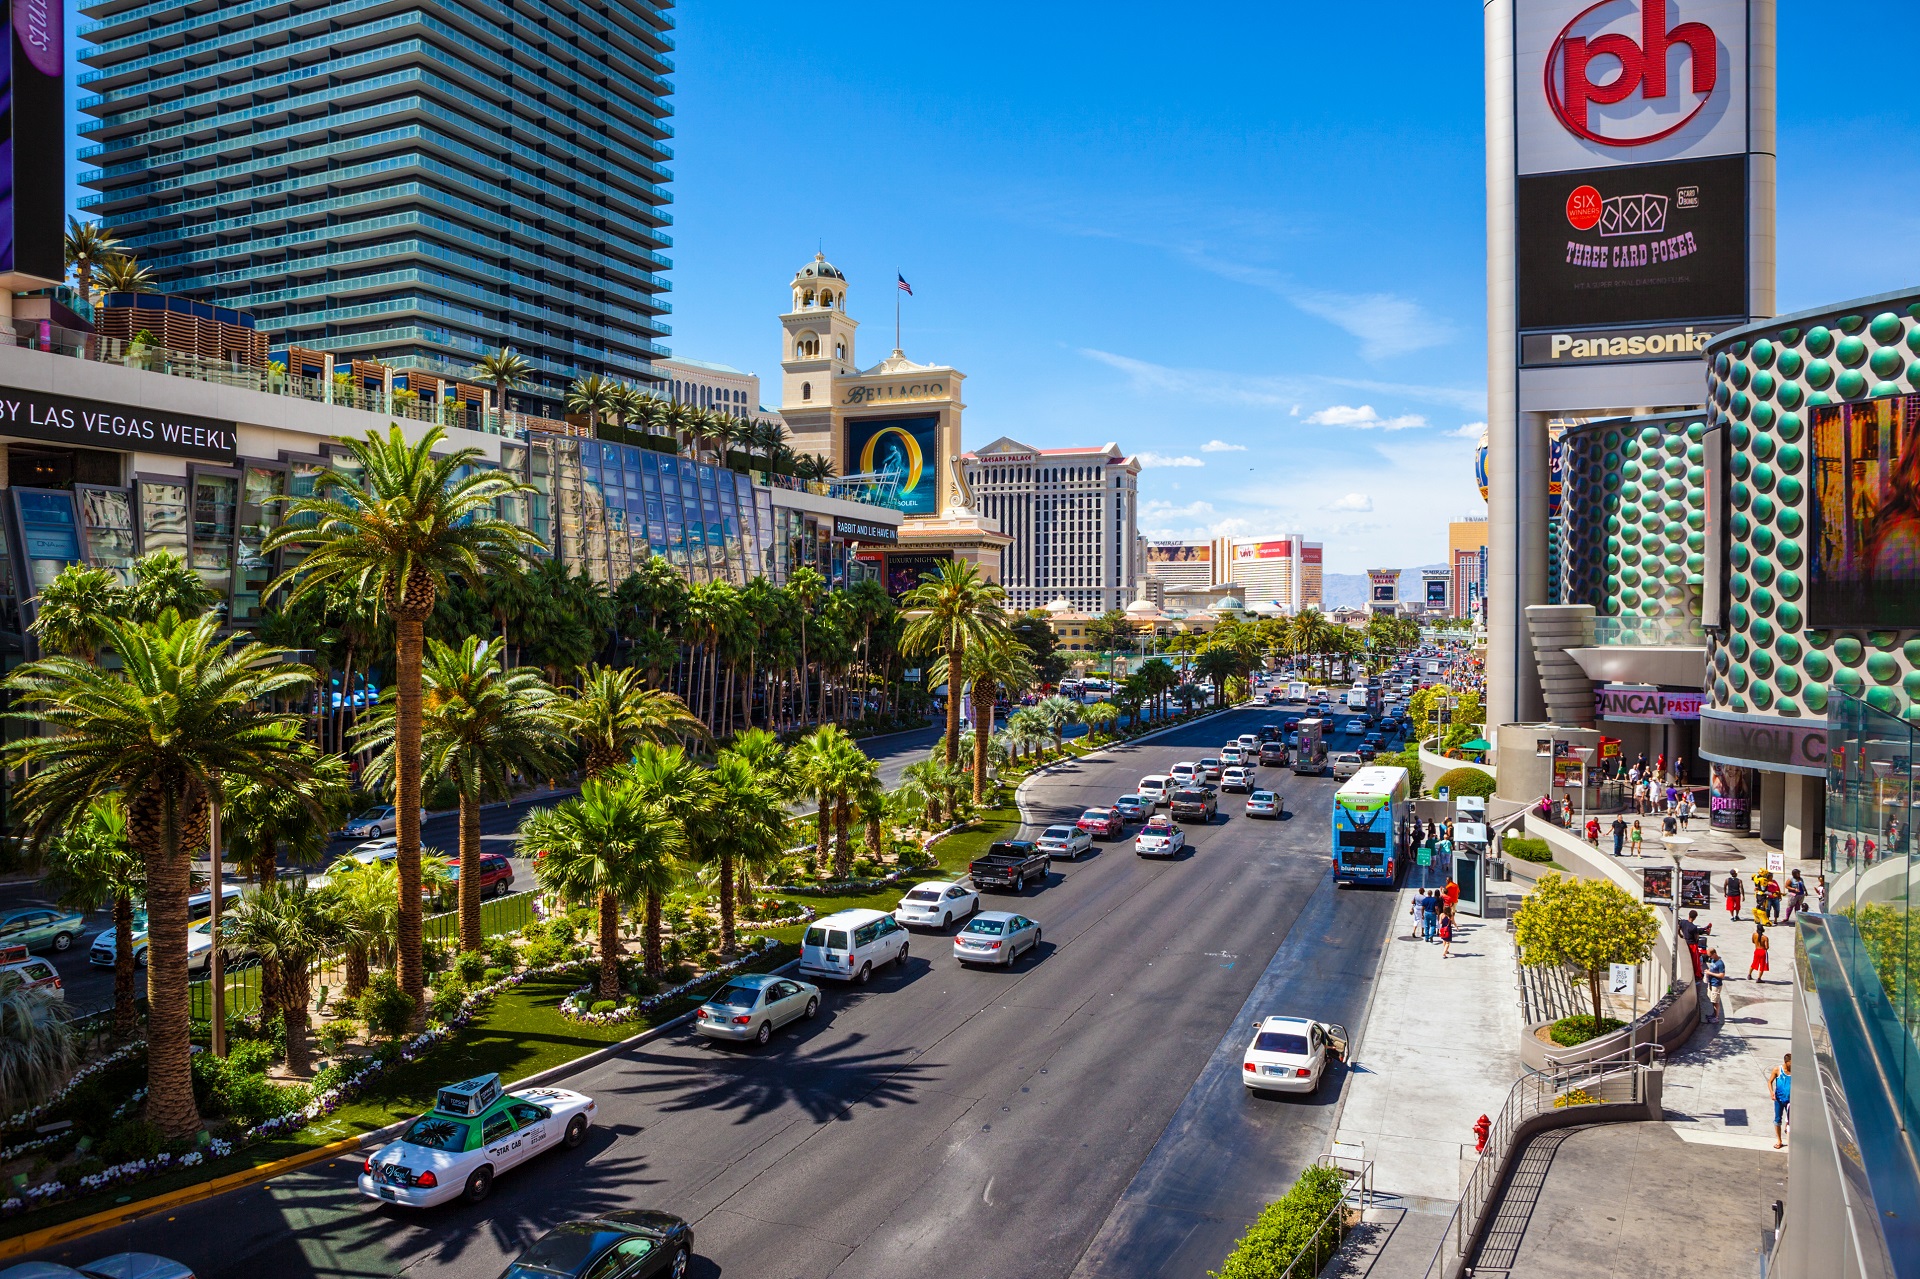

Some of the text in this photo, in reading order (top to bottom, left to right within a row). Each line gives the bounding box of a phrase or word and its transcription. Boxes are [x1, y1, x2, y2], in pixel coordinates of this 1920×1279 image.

[1573, 194, 1595, 209] SIX
[1569, 207, 1600, 216] WINNERS
[1565, 231, 1697, 269] THREE CARD POKER
[30, 403, 75, 430] LAS
[83, 411, 155, 440] VEGAS
[837, 521, 857, 534] RABBIT
[857, 524, 868, 536] AND
[868, 526, 877, 537] LIE
[876, 528, 889, 539] HAVE
[889, 530, 896, 540] IN
[1802, 733, 1826, 763] C
[1340, 865, 1384, 873] blueman.com
[496, 1139, 522, 1157] STAR CAB
